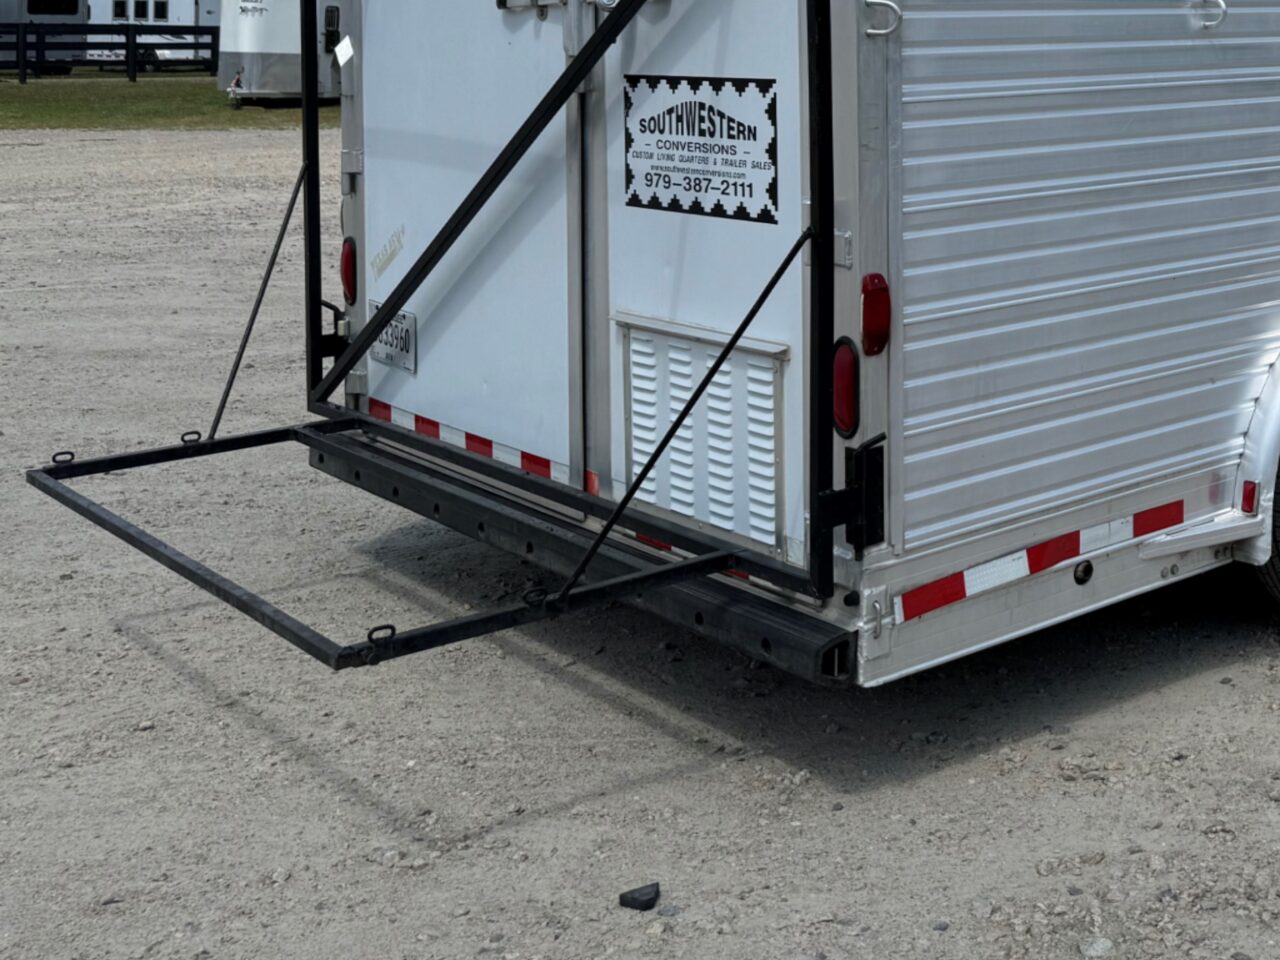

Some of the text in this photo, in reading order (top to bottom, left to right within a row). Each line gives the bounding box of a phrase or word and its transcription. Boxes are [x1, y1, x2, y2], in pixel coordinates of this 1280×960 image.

[639, 100, 758, 142] SOUTHWESTERN
[655, 139, 738, 156] CONVERSIONS
[720, 157, 747, 169] TRAILER
[750, 160, 772, 171] SALES
[644, 171, 753, 198] 979-387-2111
